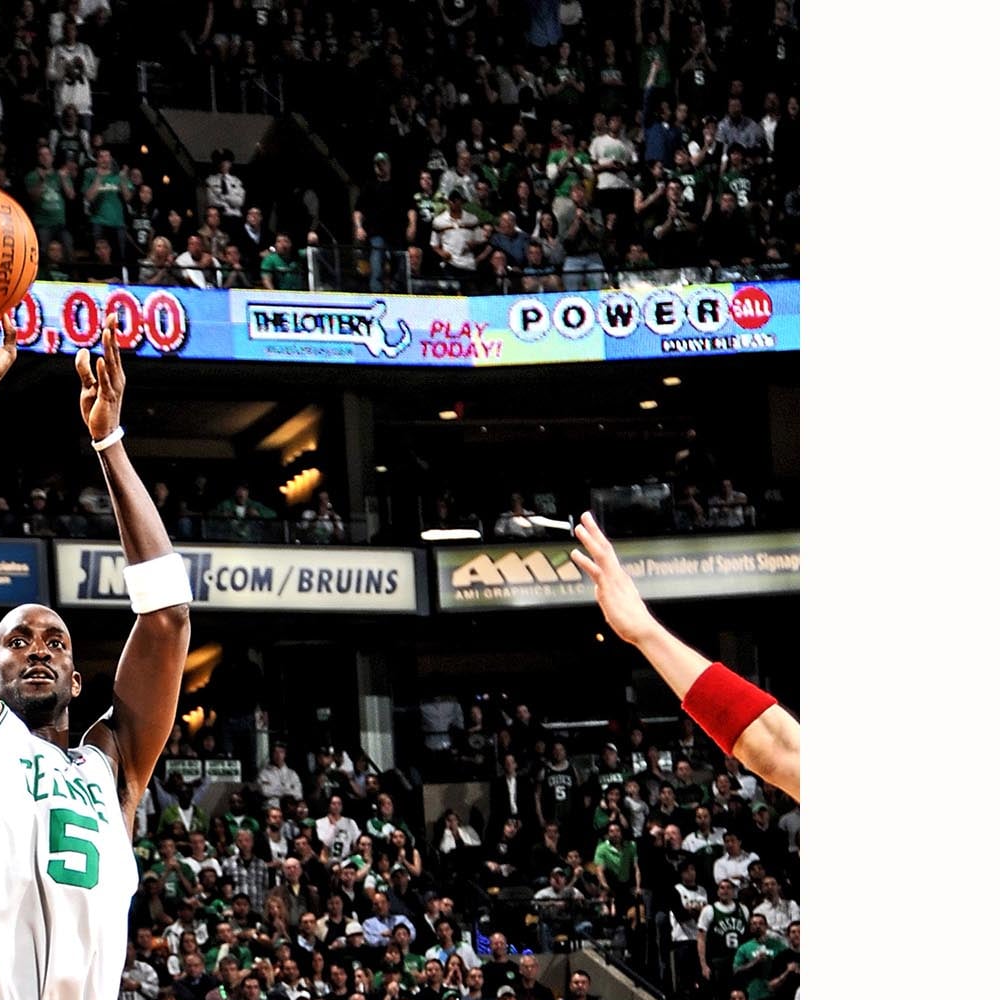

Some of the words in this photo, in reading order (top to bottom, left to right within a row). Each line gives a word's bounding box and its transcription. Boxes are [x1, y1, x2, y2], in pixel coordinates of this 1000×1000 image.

[254, 311, 289, 332] THE
[293, 312, 375, 337] LOTTERY
[522, 299, 719, 331] POWER
[430, 320, 489, 338] PLAY
[420, 340, 503, 359] TODAY!
[701, 556, 714, 573] of
[555, 786, 566, 801] 5
[47, 808, 99, 890] 5
[725, 932, 738, 949] 6
